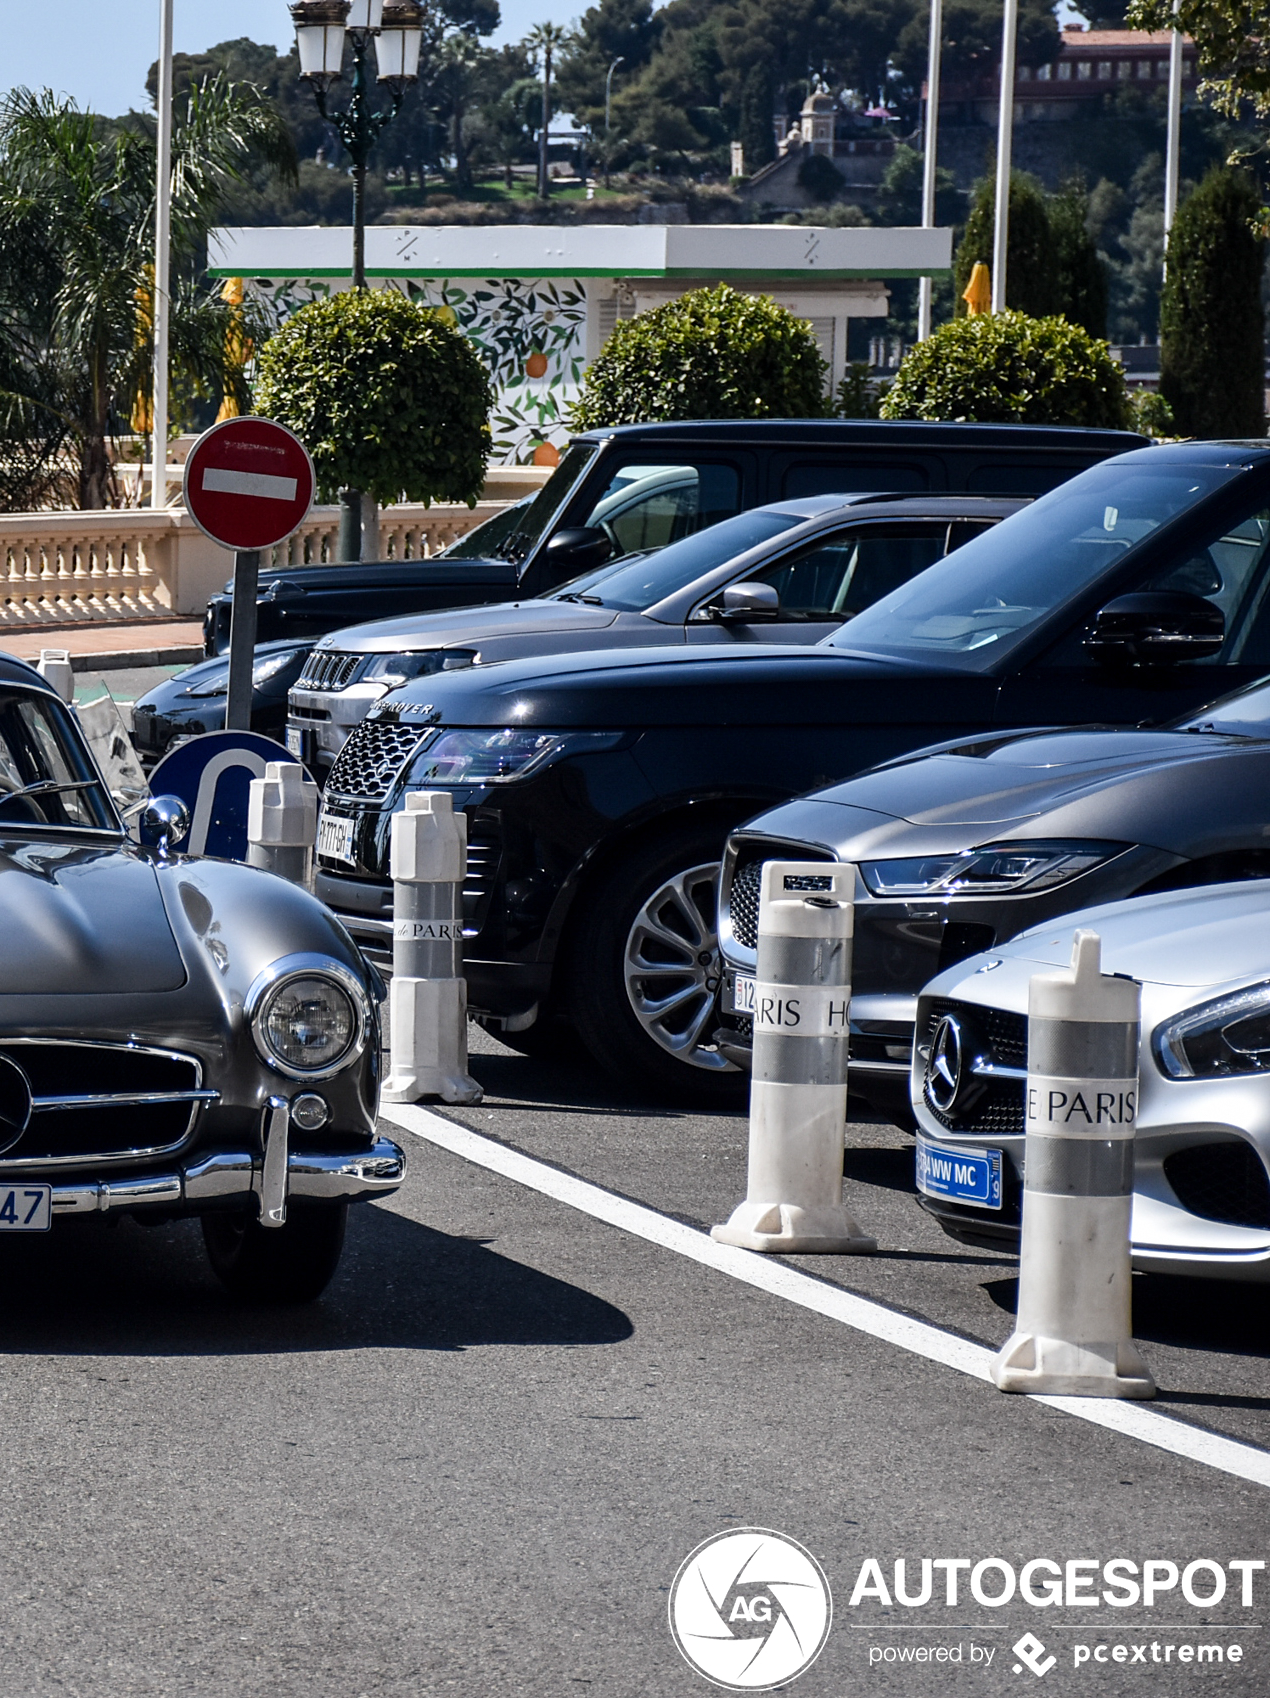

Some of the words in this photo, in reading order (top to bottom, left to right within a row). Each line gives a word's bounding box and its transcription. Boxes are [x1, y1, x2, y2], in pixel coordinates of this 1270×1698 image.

[412, 922, 463, 940] PARIS
[1048, 1090, 1135, 1124] PARIS
[954, 1163, 977, 1187] MC
